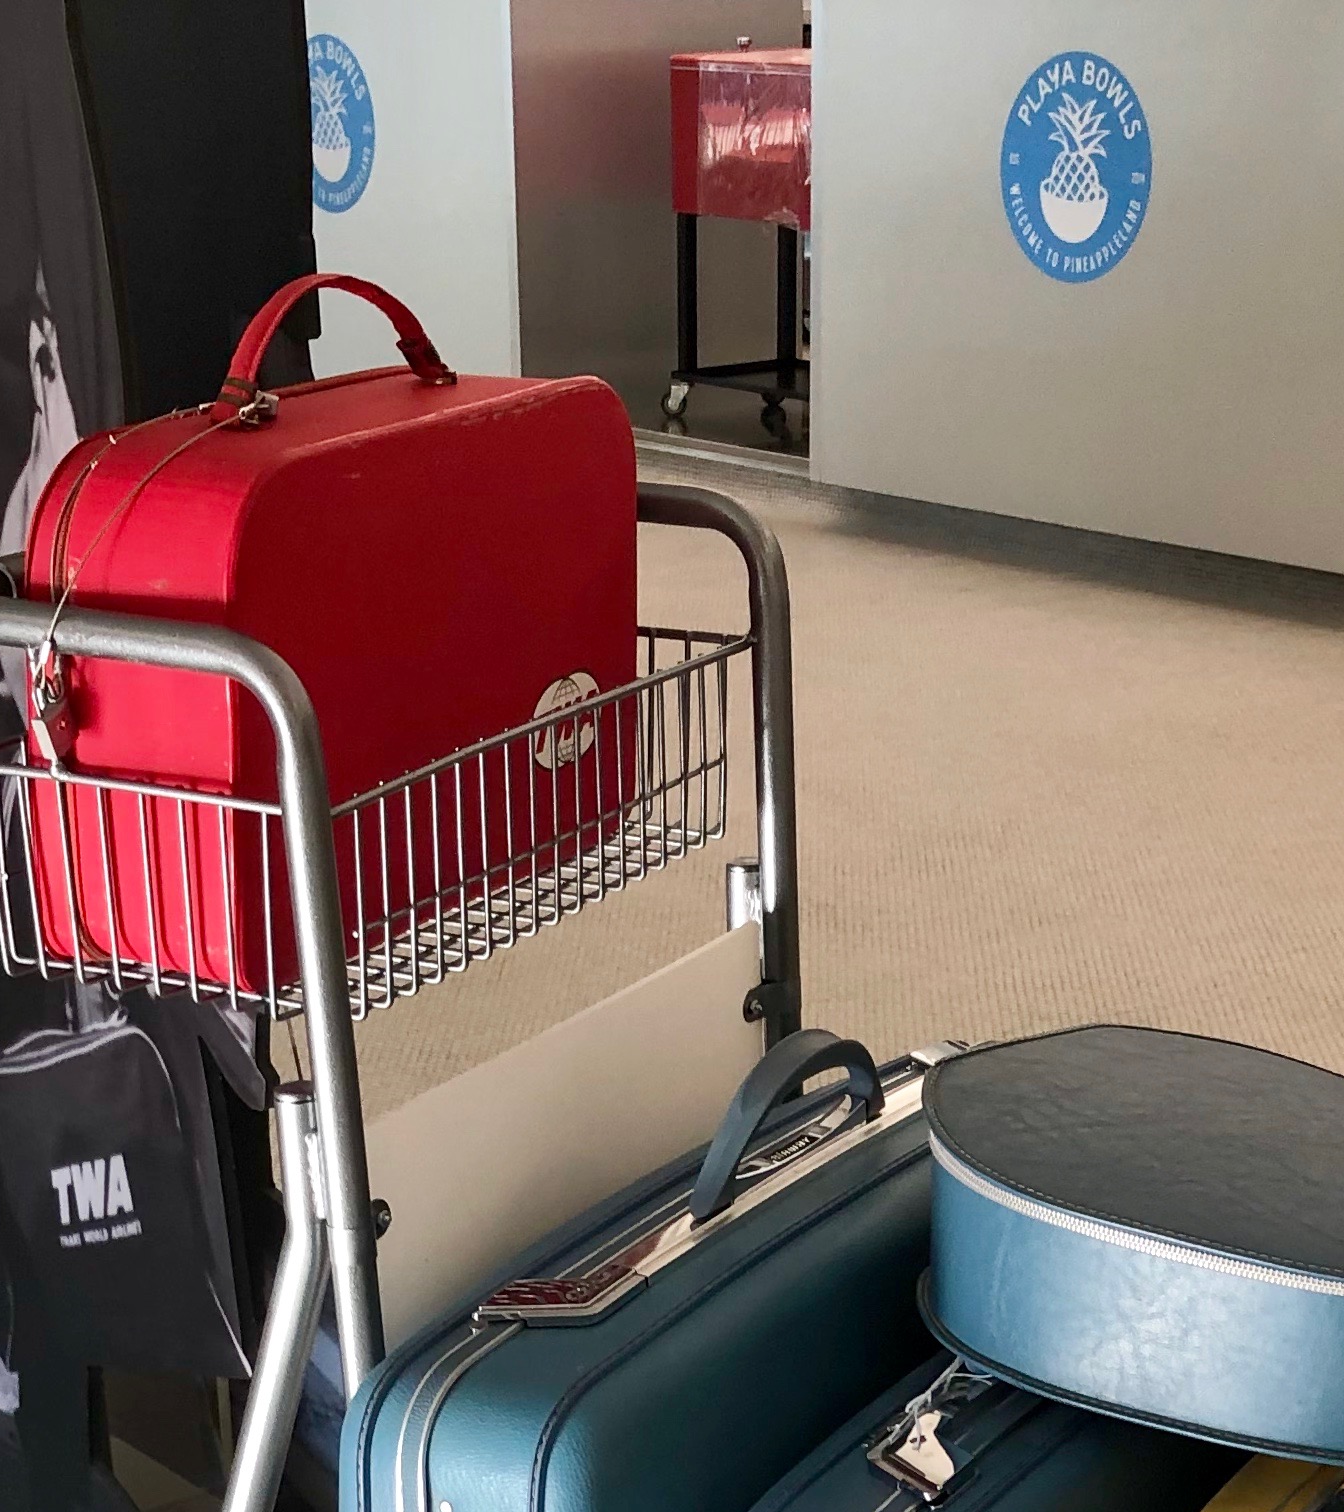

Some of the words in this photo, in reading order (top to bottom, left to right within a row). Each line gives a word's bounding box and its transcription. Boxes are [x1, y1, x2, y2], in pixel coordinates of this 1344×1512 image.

[1017, 60, 1076, 127] PLAYA
[1081, 59, 1142, 140] BOWLS
[1009, 182, 1044, 256] WELCOME
[1046, 248, 1060, 268] TO
[50, 1152, 134, 1226] TWA
